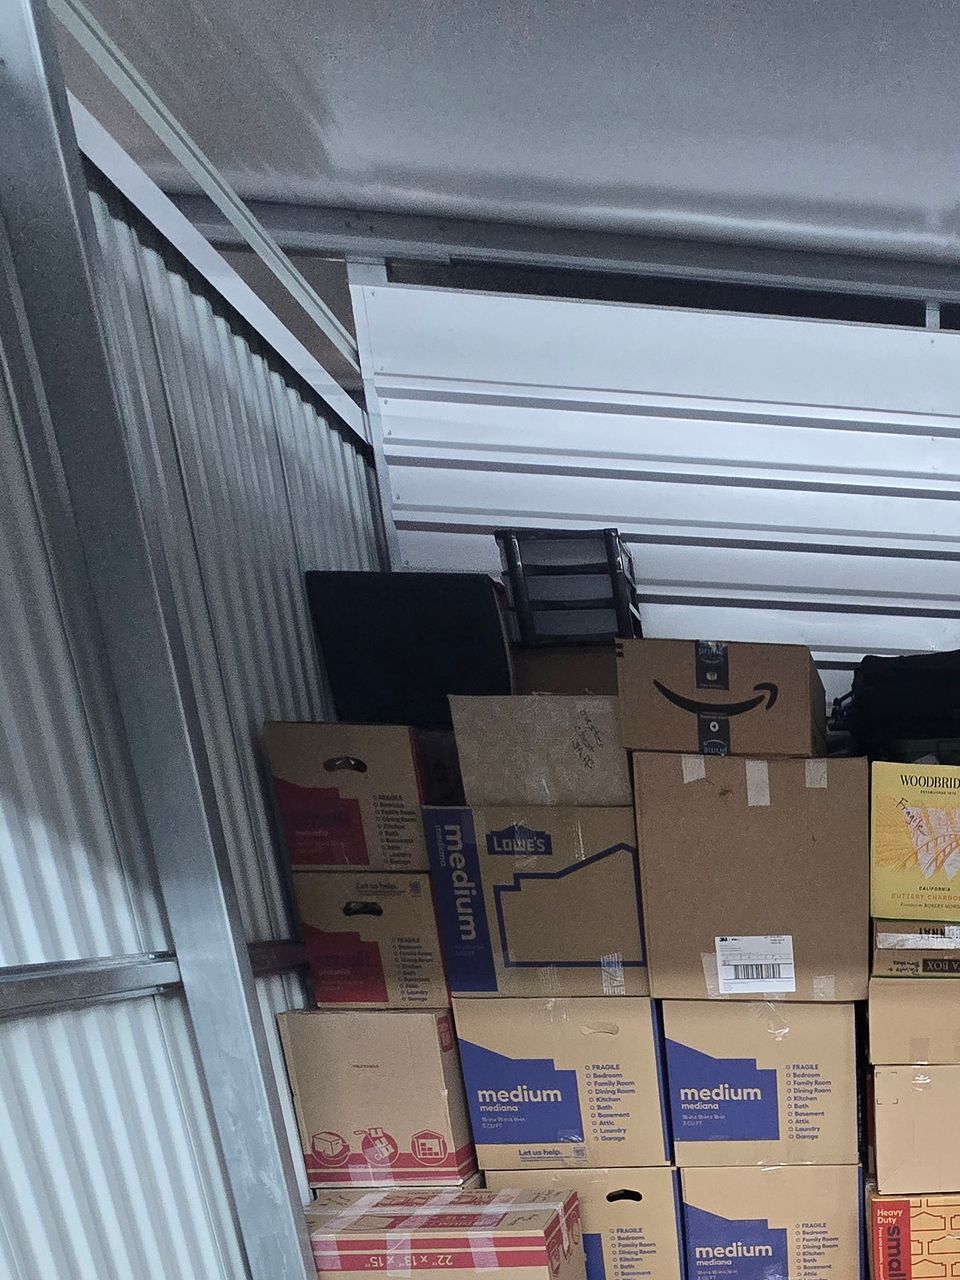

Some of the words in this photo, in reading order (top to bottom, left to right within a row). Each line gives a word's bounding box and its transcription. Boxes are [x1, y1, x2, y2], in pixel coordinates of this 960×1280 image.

[896, 797, 928, 836] Fragile
[444, 824, 478, 940] medium
[926, 961, 949, 971] BOX
[477, 1084, 562, 1103] medium
[680, 1084, 761, 1101] medium
[480, 1104, 518, 1112] mediana
[681, 1102, 719, 1110] mediana
[877, 1209, 903, 1217] Heavy
[695, 1242, 772, 1258] medium
[365, 1256, 383, 1267] 15"
[386, 1257, 394, 1265] x
[421, 1256, 428, 1264] x
[432, 1255, 453, 1266] 22"
